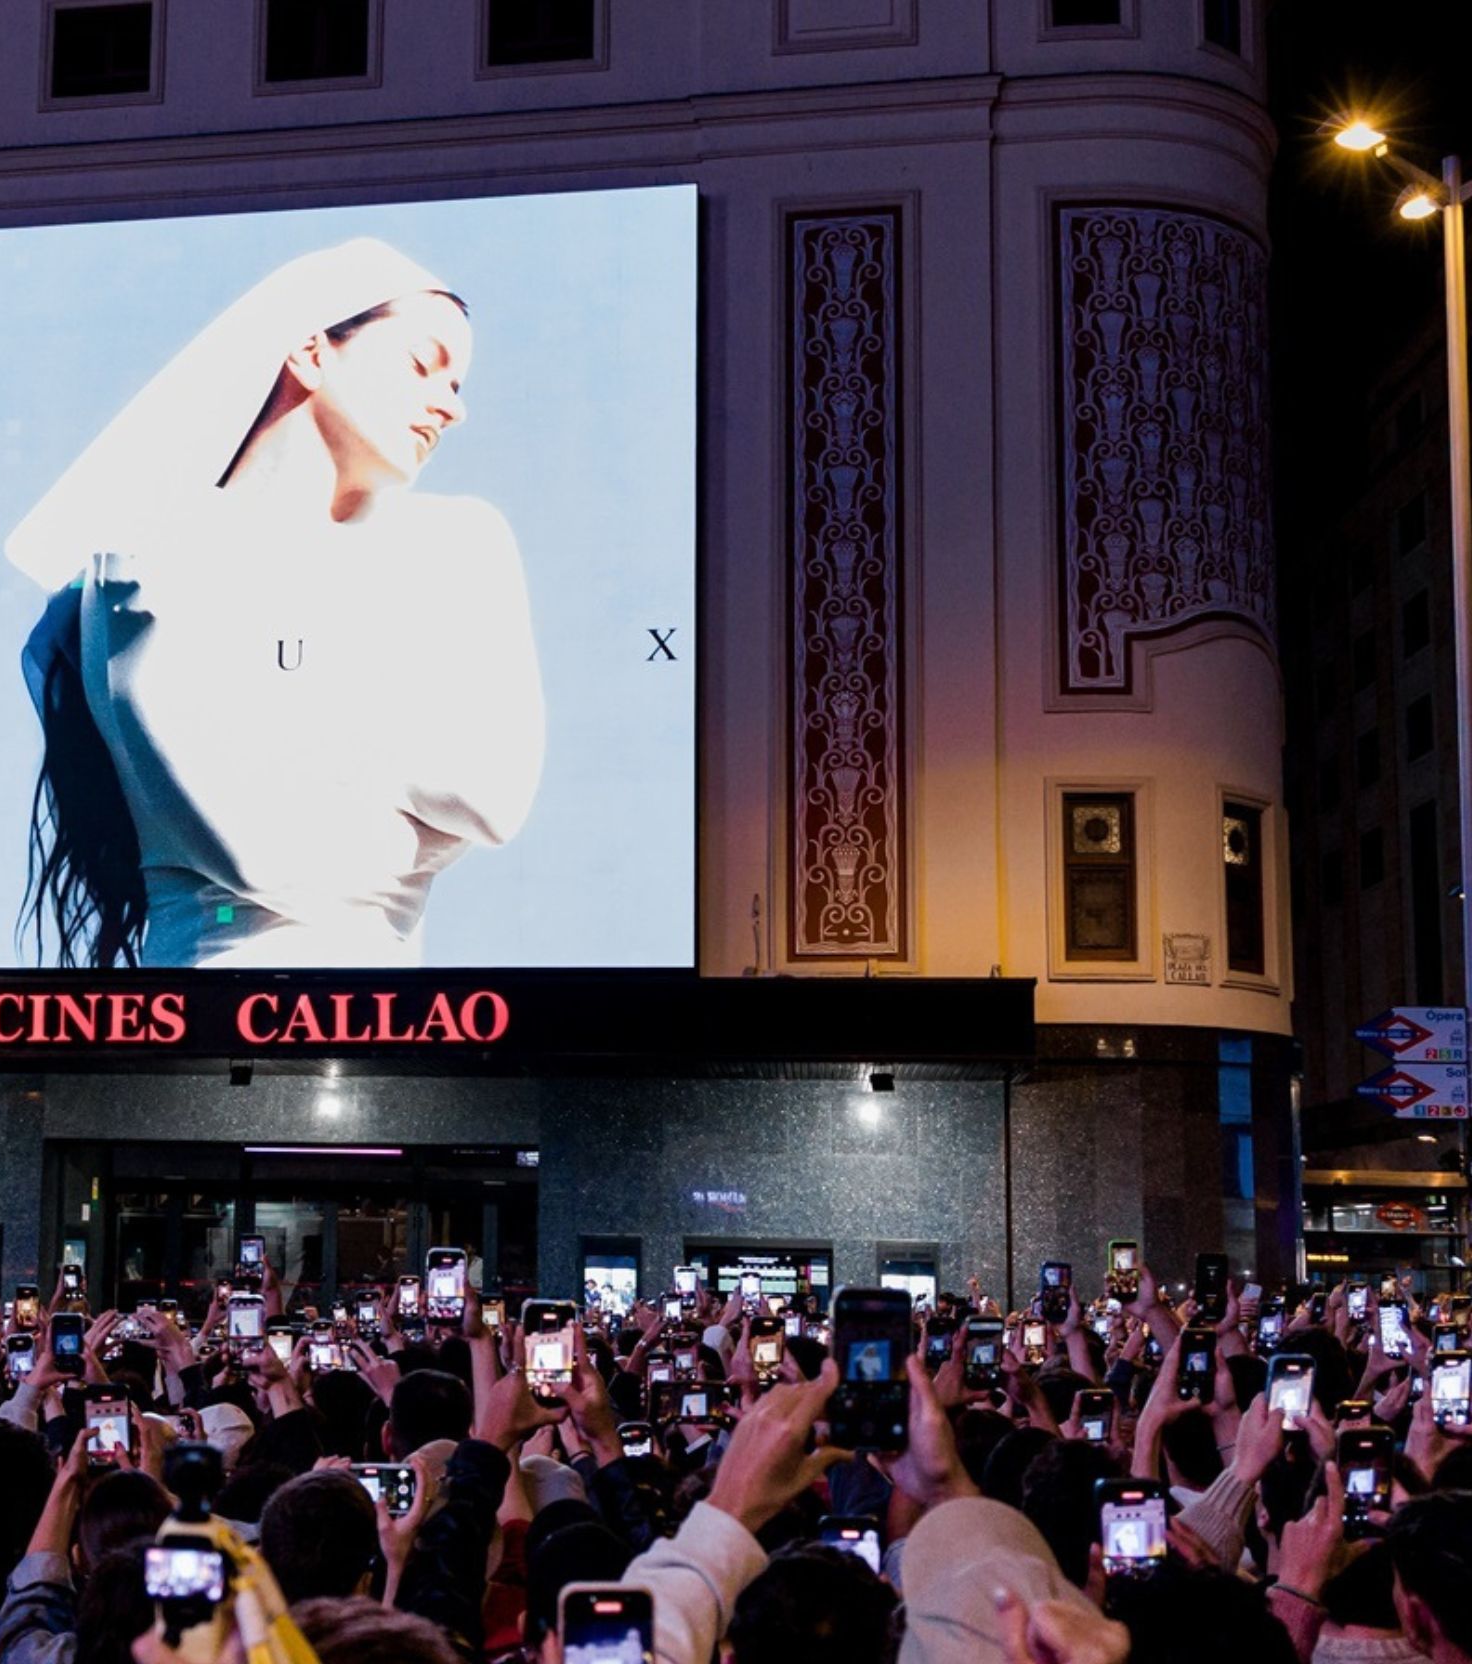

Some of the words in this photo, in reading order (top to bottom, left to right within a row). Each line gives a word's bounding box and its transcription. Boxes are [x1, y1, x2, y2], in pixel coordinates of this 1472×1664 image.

[277, 639, 304, 671] U
[646, 627, 679, 662] X
[237, 991, 509, 1043] CALLAO
